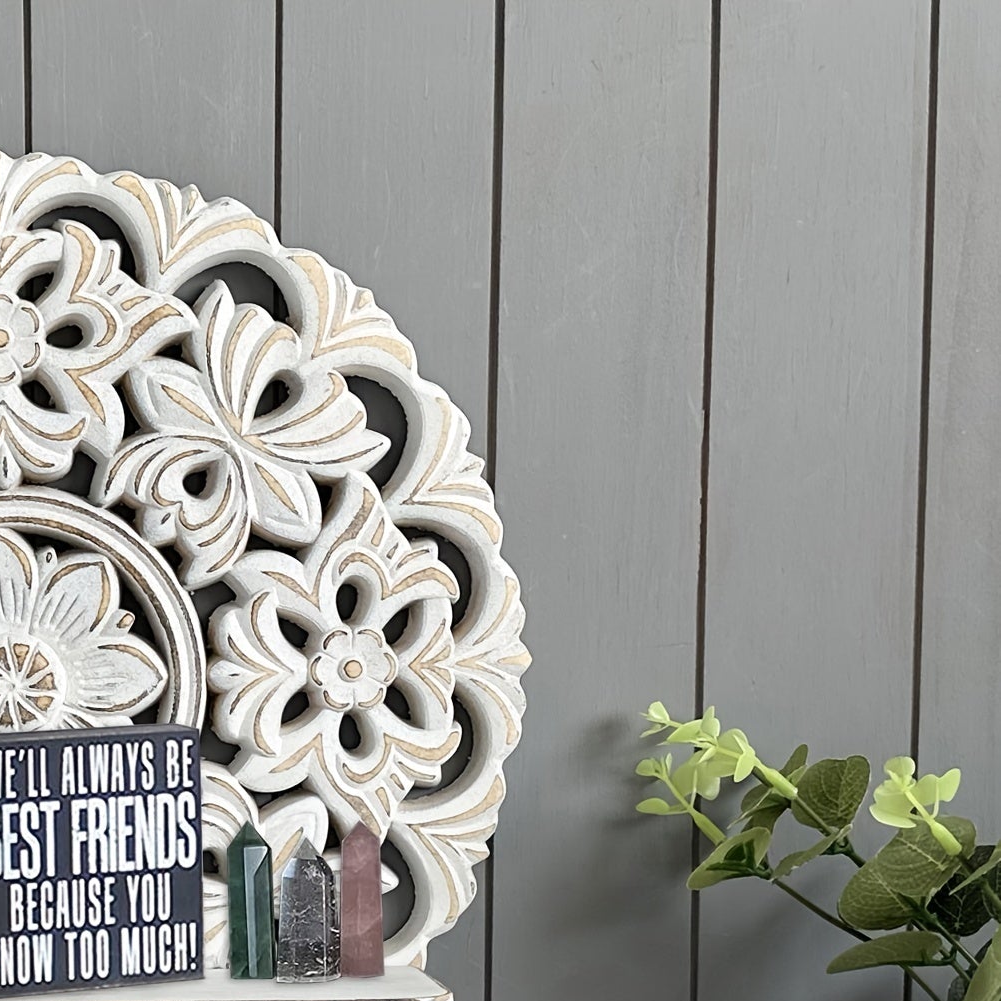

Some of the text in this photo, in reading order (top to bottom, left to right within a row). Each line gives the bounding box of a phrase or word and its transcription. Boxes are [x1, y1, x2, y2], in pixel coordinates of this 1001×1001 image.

[61, 741, 154, 796] ALWAYS
[166, 739, 194, 789] BE
[71, 791, 197, 876] FRIENDS
[10, 872, 171, 932] BECAUSE YOU
[64, 929, 109, 980] TOO
[121, 922, 197, 975] MUCH!
